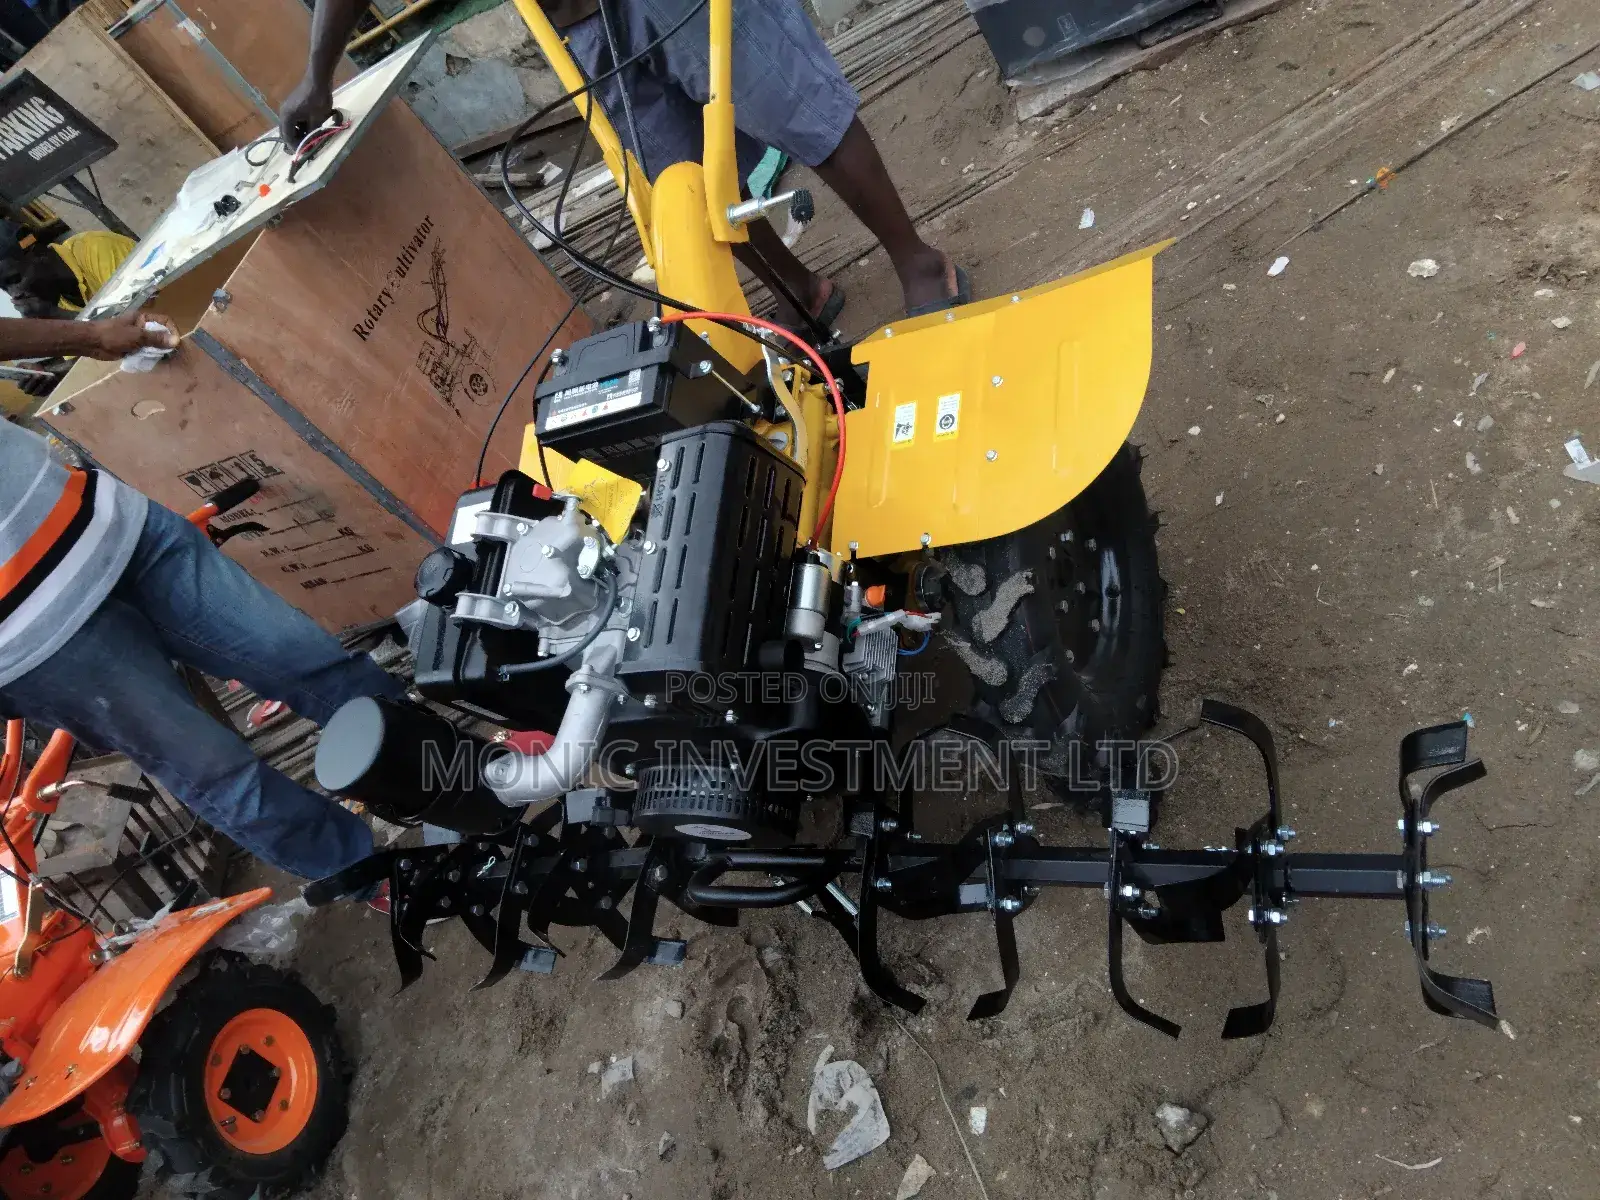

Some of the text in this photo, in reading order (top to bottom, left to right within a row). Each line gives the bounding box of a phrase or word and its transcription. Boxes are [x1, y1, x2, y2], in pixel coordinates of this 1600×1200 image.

[0, 96, 65, 160] ARKING
[28, 140, 57, 160] ORDER
[48, 134, 65, 148] BY
[352, 287, 395, 342] Rotary
